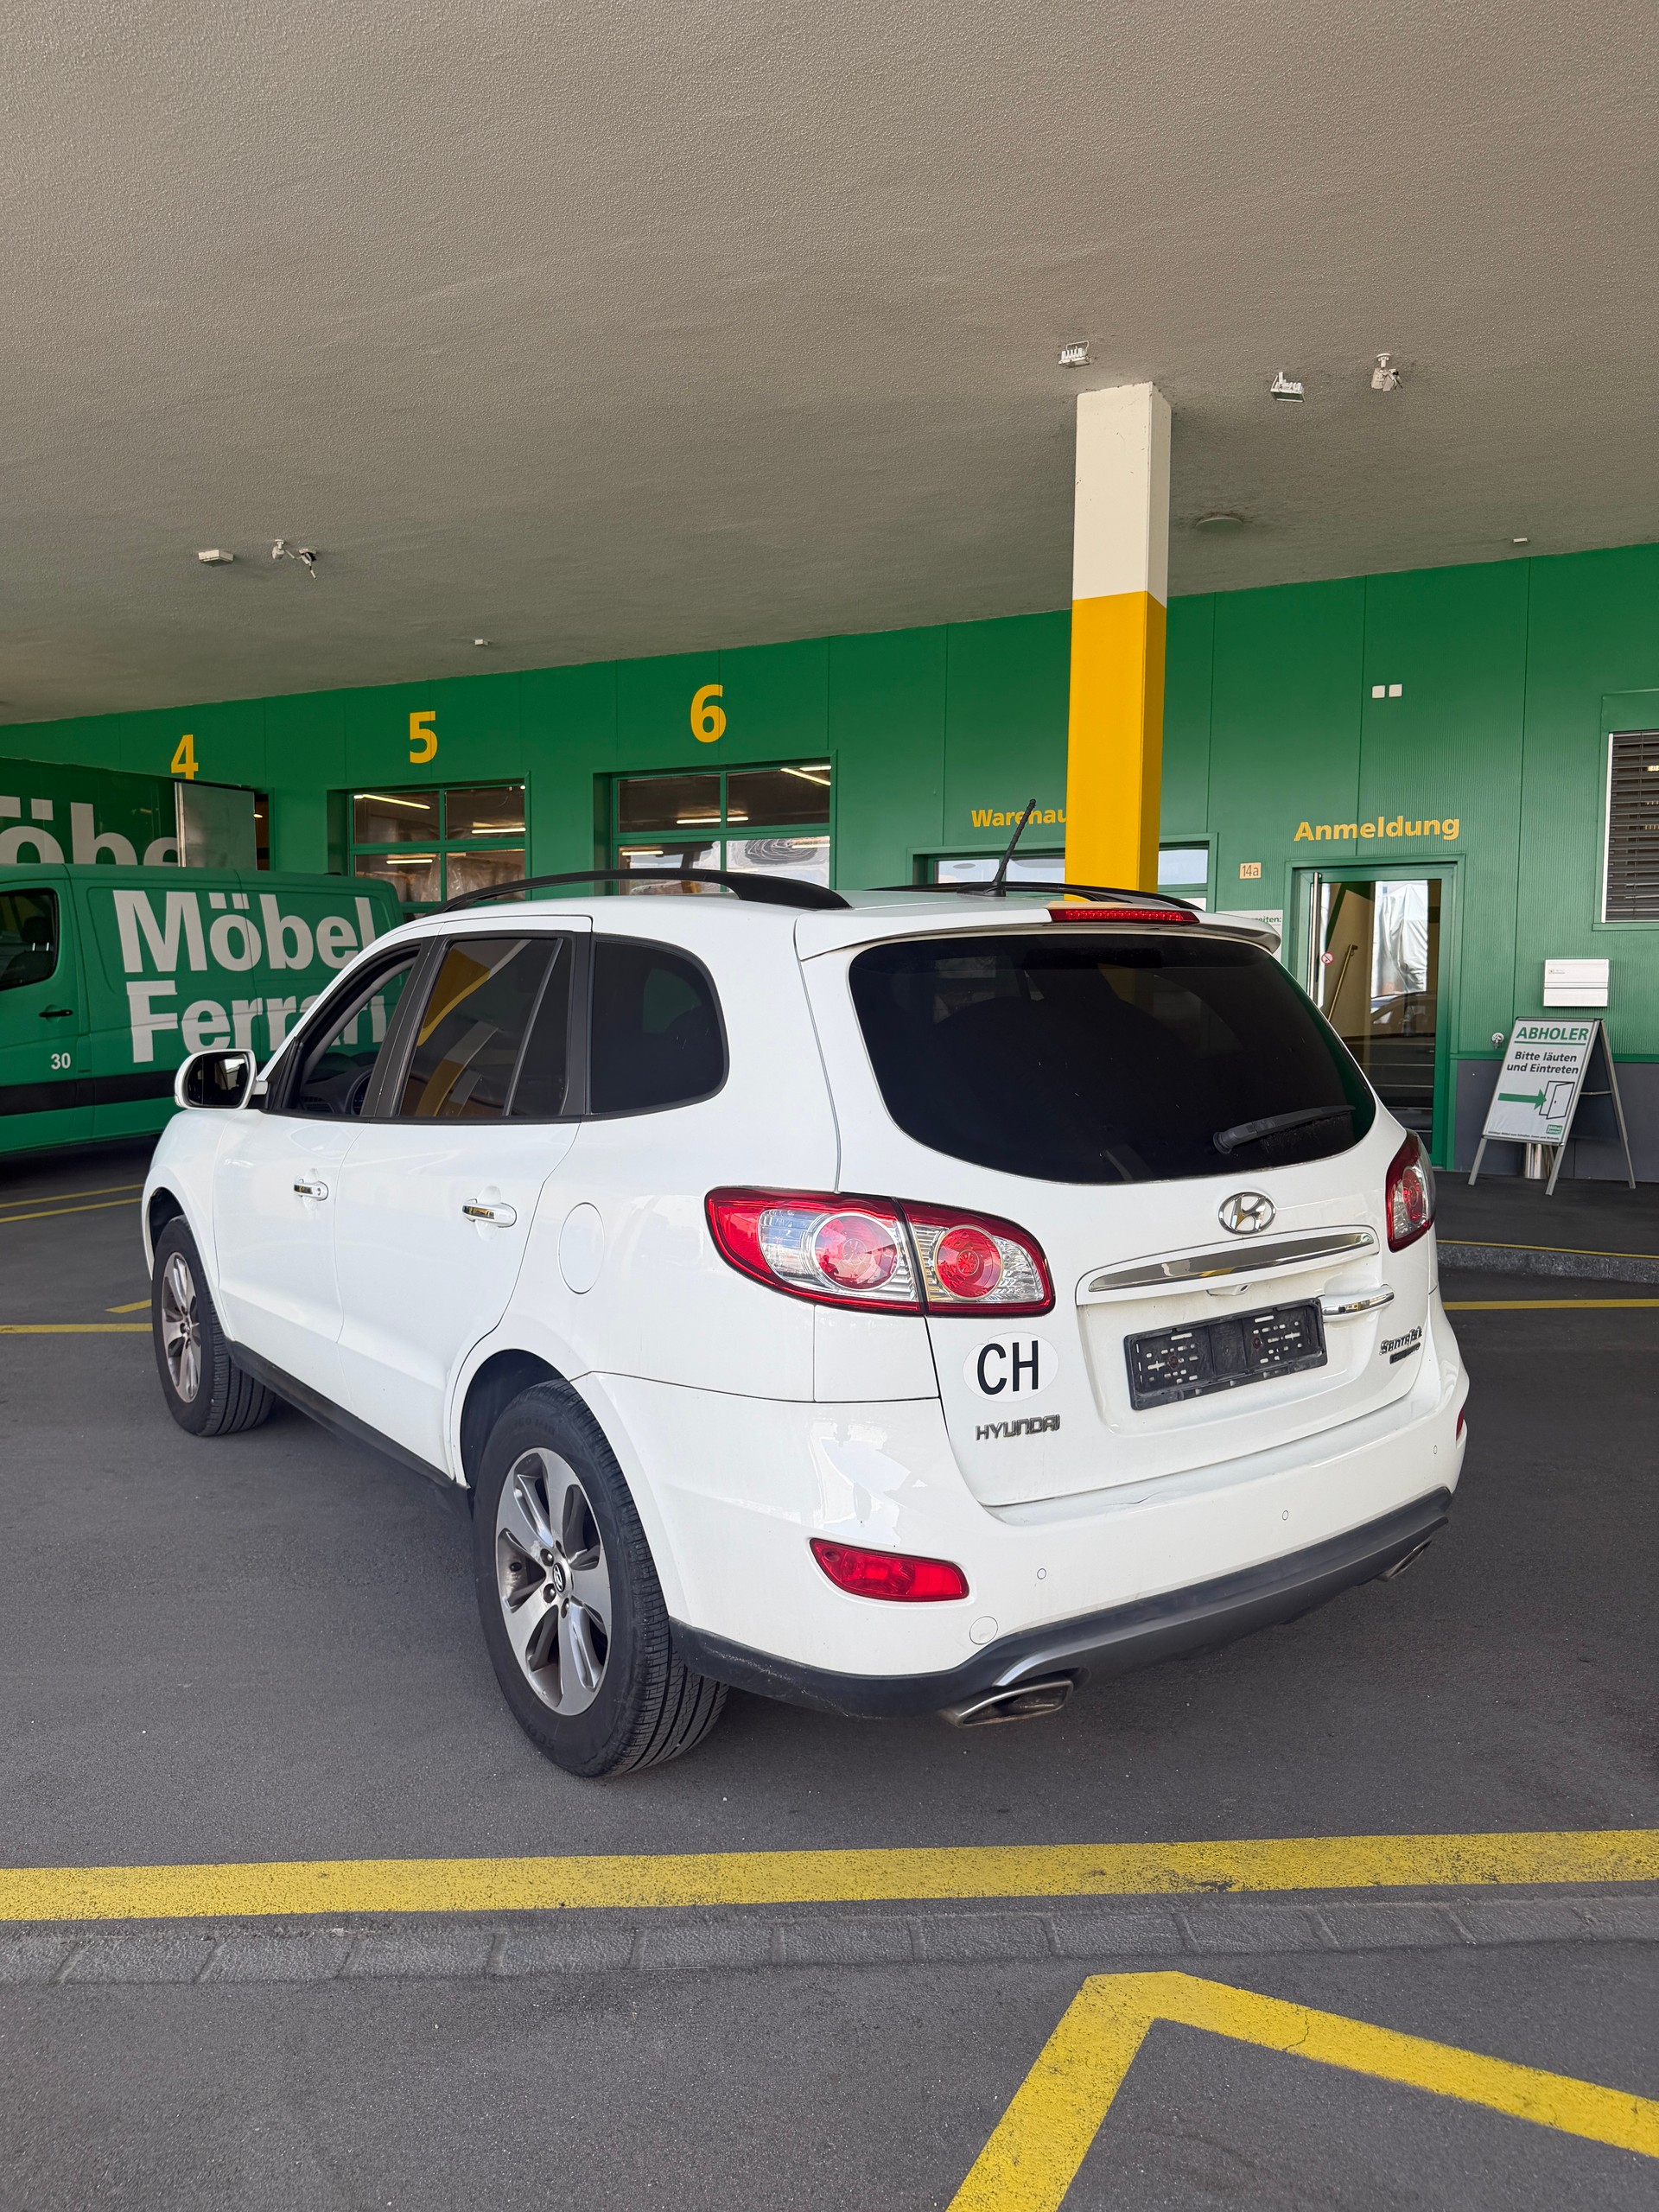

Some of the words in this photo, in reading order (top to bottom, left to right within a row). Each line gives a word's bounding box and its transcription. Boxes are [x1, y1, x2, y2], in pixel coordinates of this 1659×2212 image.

[690, 683, 727, 743] 6
[409, 710, 438, 763] 5
[170, 734, 199, 779] 4
[1294, 815, 1460, 842] Anmeldung
[1243, 865, 1259, 877] 14a
[112, 890, 378, 973] Möbel
[1516, 1027, 1589, 1040] ABHOLER
[50, 1052, 71, 1070] 30
[1506, 1063, 1529, 1072] und
[1529, 1064, 1580, 1075] Eintreten
[1514, 1051, 1541, 1061] Bitte
[1543, 1052, 1577, 1063] läuten
[977, 1340, 1039, 1395] CH
[976, 1414, 1061, 1440] HYUNDAI
